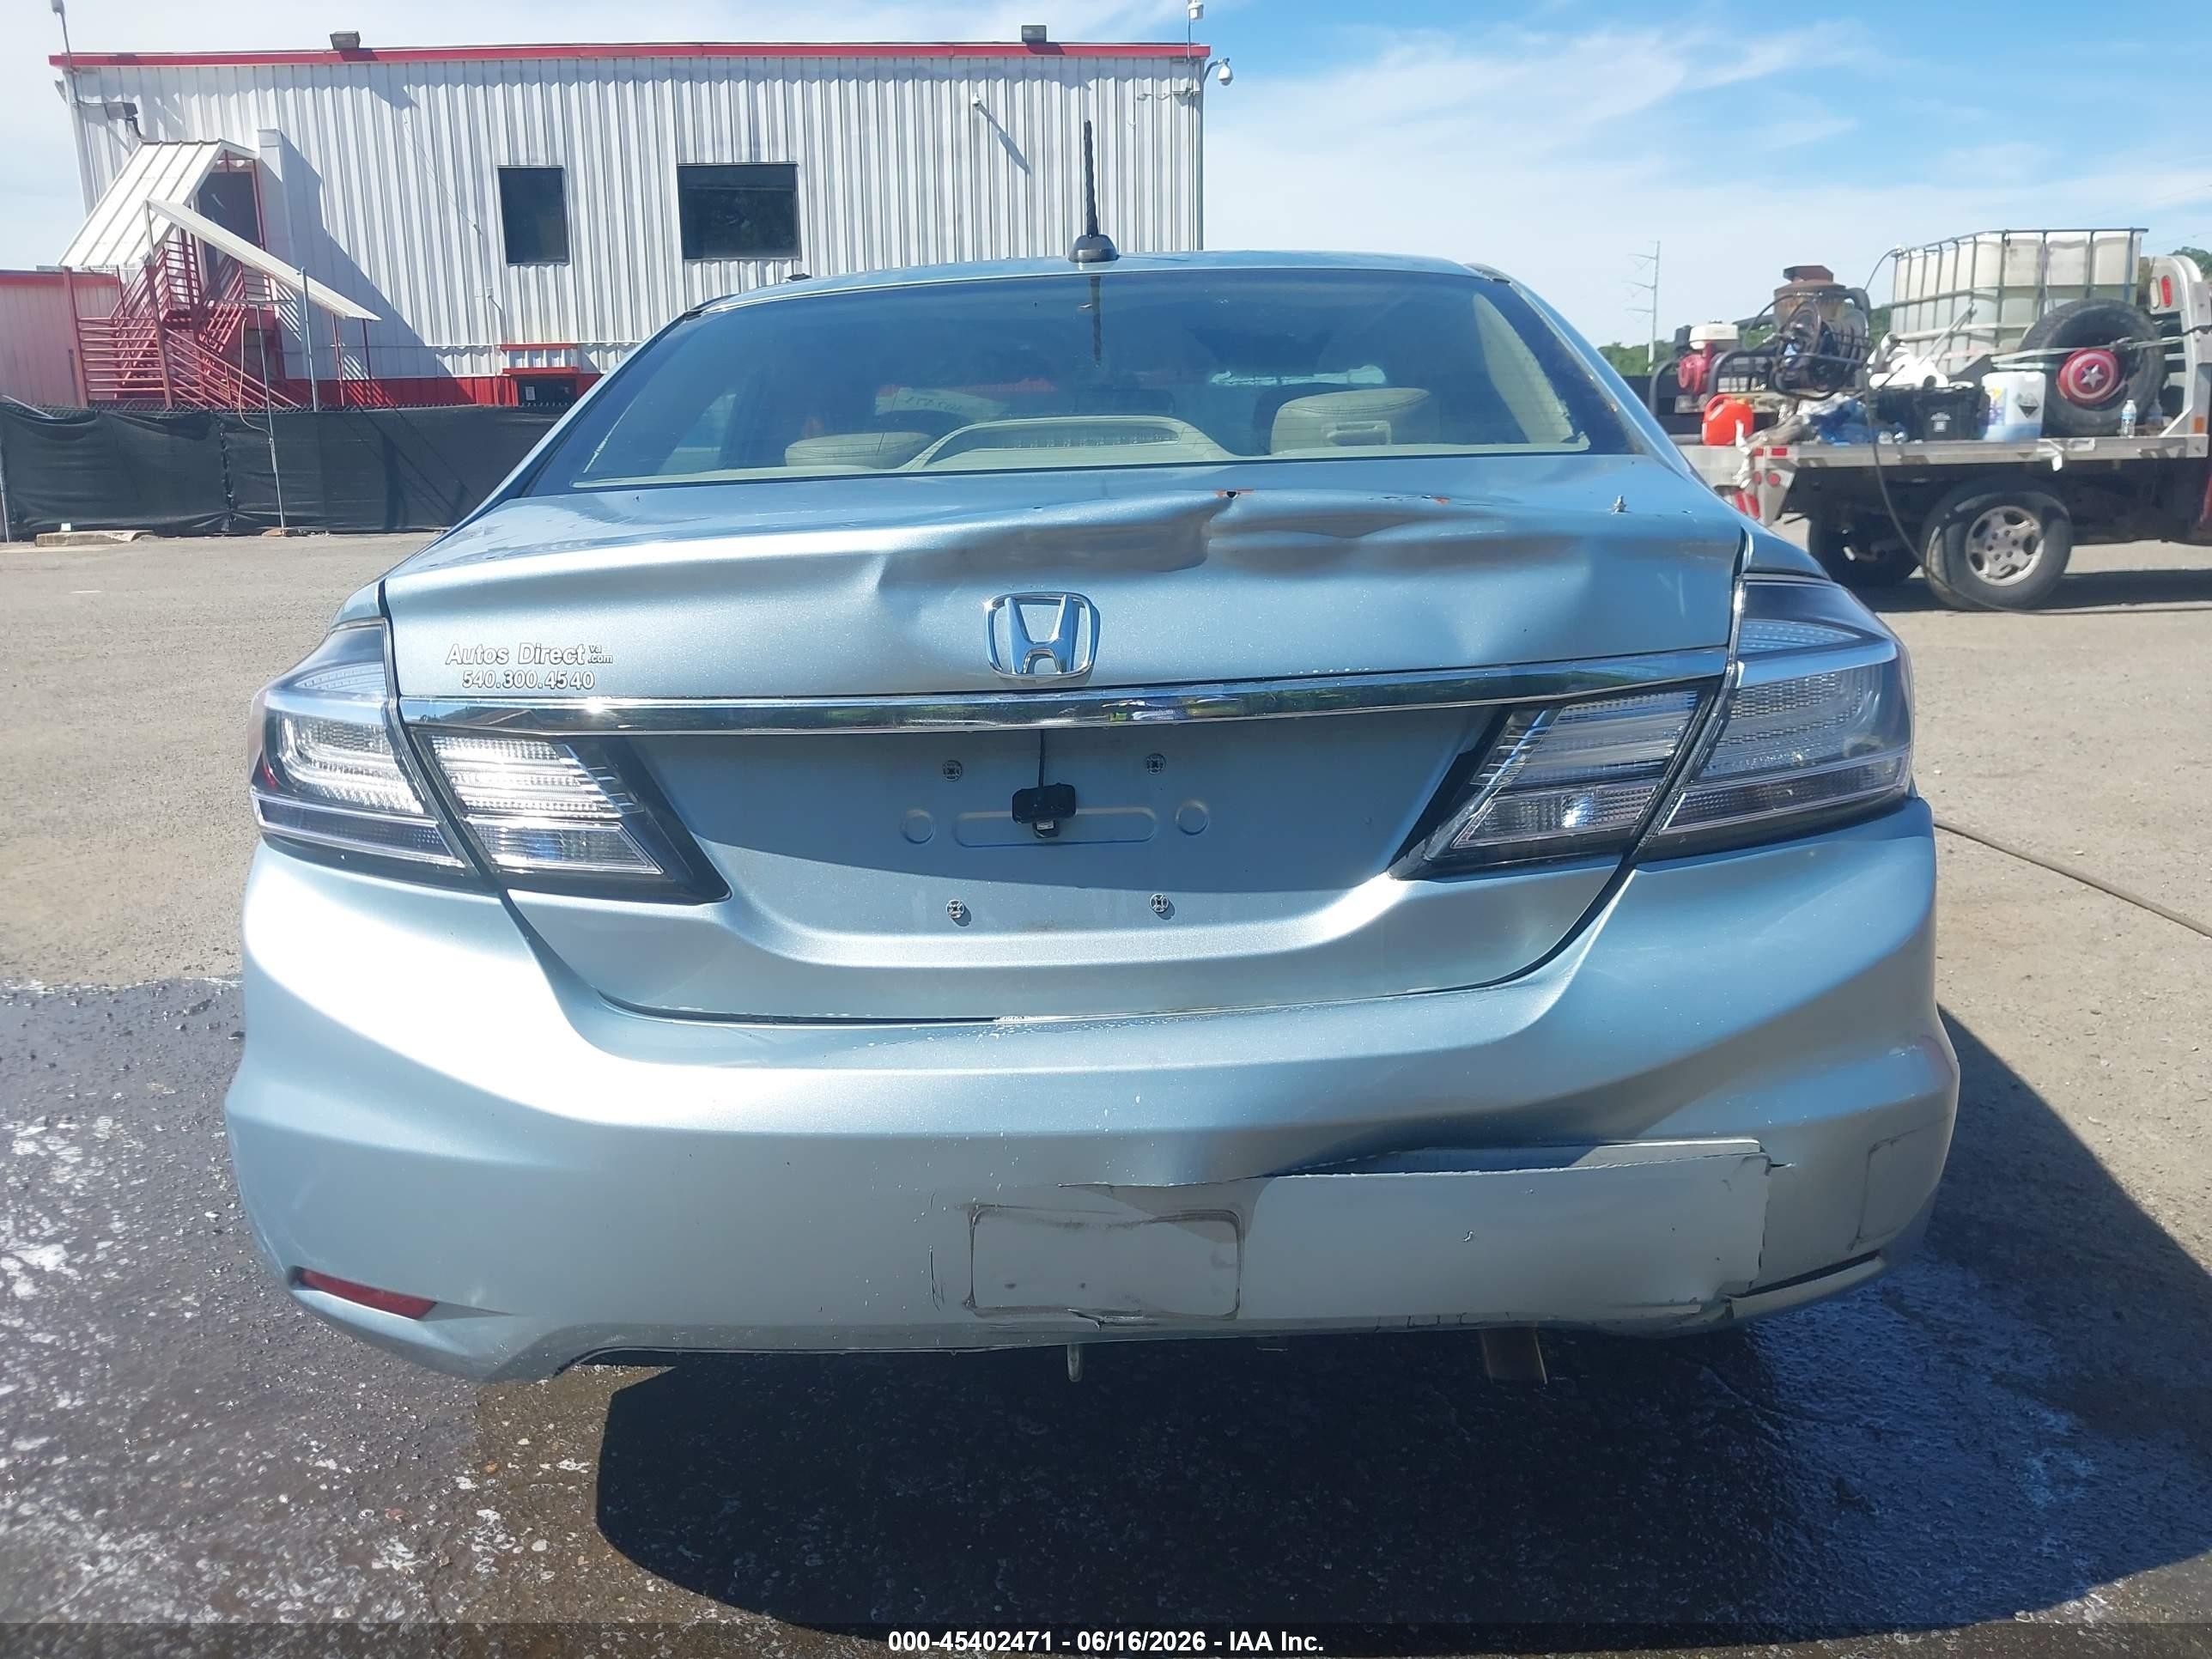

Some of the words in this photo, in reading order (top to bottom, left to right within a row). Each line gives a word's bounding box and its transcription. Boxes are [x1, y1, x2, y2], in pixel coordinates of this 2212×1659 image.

[446, 643, 509, 665] Autos
[518, 642, 585, 665] Direct
[462, 670, 595, 690] 540.300.4540
